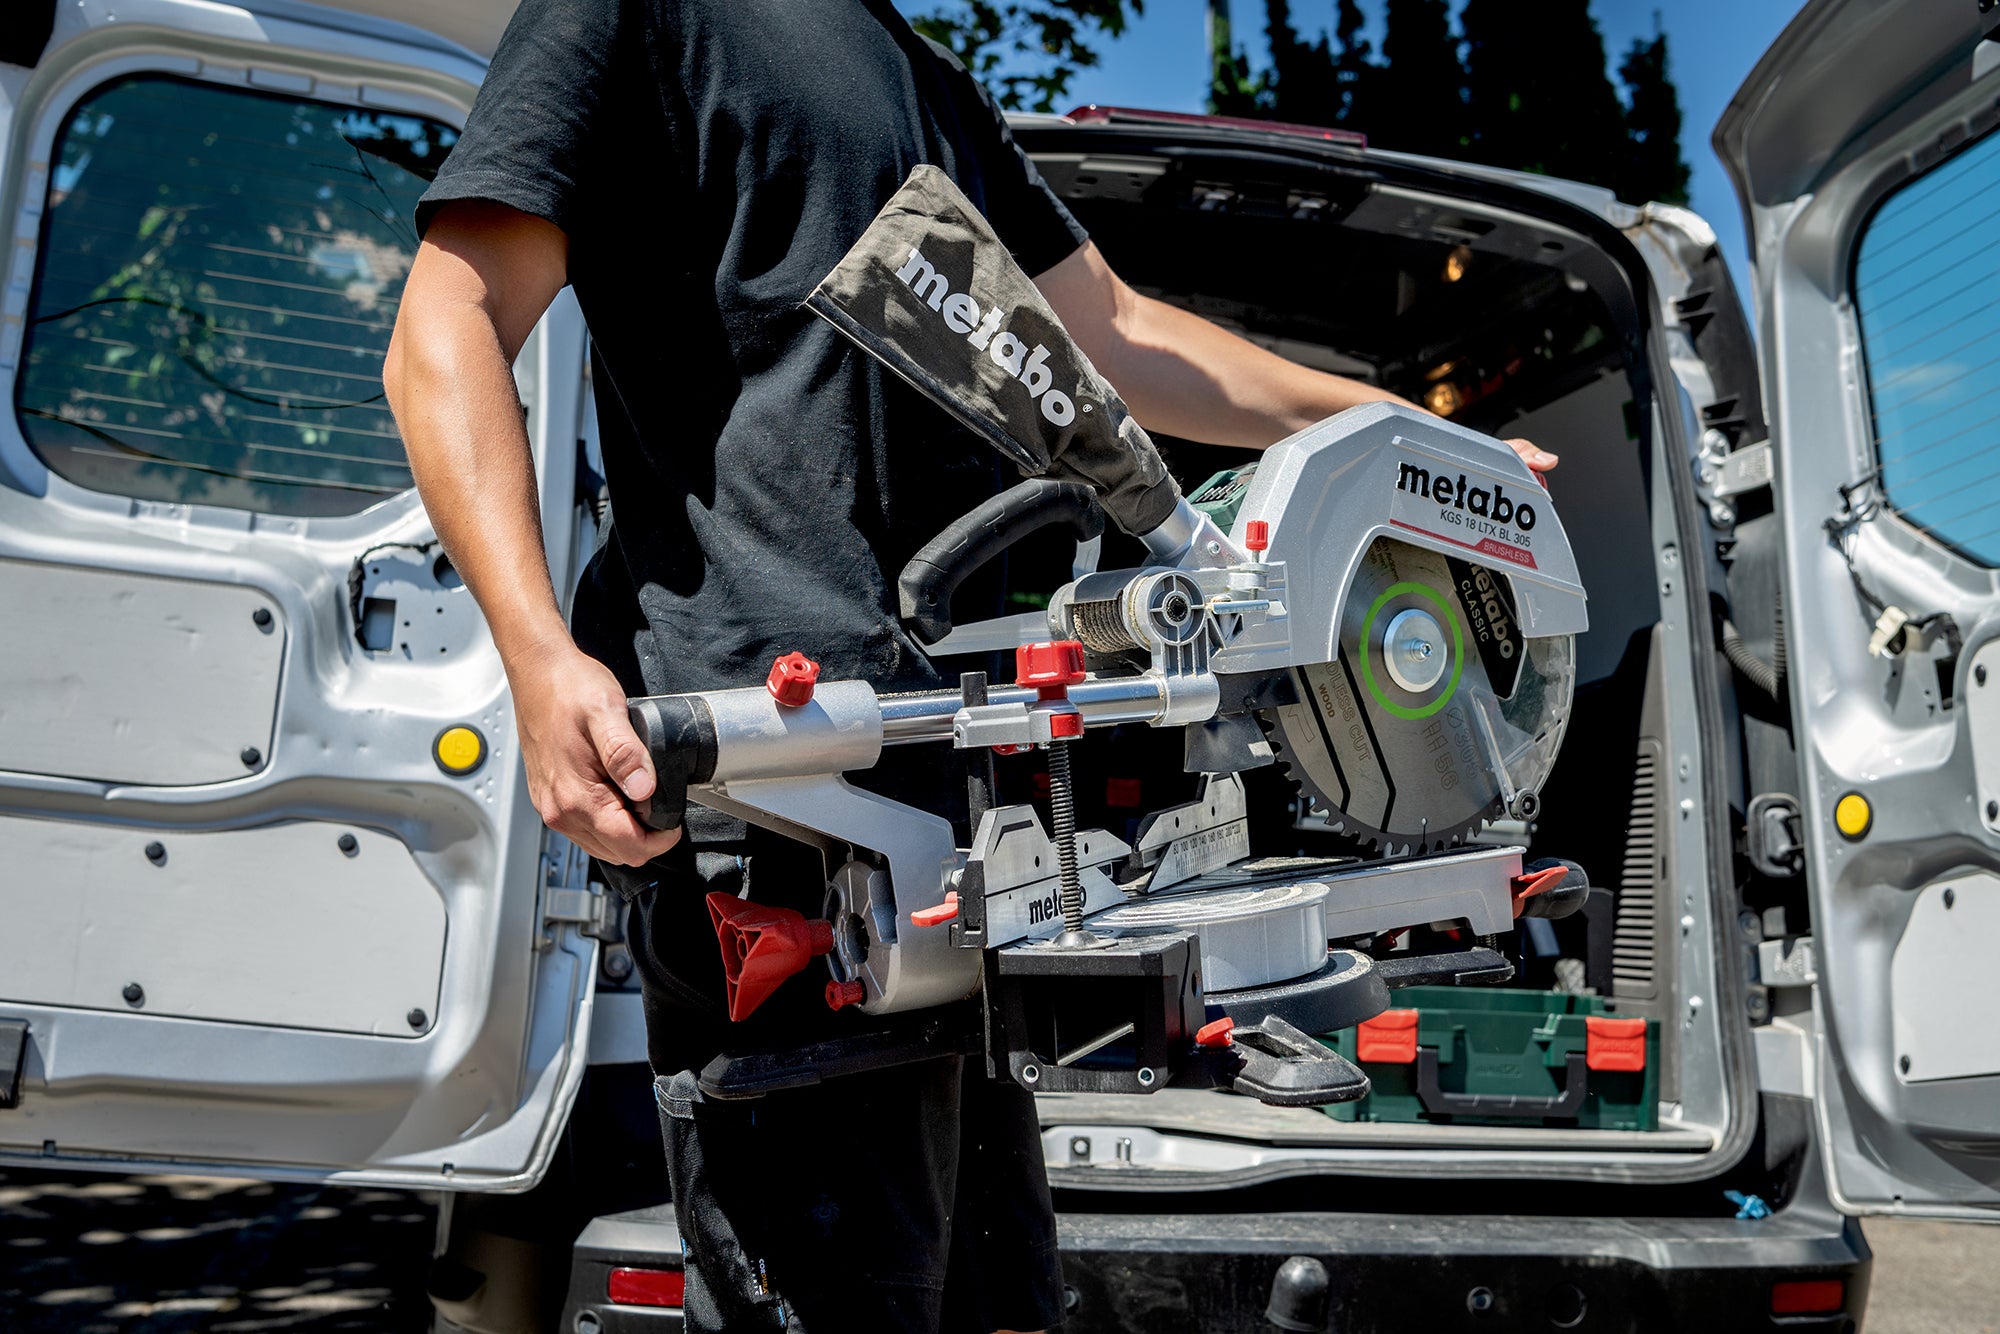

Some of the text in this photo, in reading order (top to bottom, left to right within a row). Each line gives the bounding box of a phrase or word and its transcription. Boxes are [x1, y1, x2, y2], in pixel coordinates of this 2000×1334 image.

[896, 247, 1075, 427] metabo
[1396, 461, 1537, 532] metabo
[1440, 508, 1531, 548] KGS 18 LTX BL 305
[1483, 541, 1530, 563] BRUSHLESS
[1461, 579, 1489, 642] CLASSIC
[1318, 683, 1336, 718] WOOD
[1325, 661, 1372, 762] DLESS CUT
